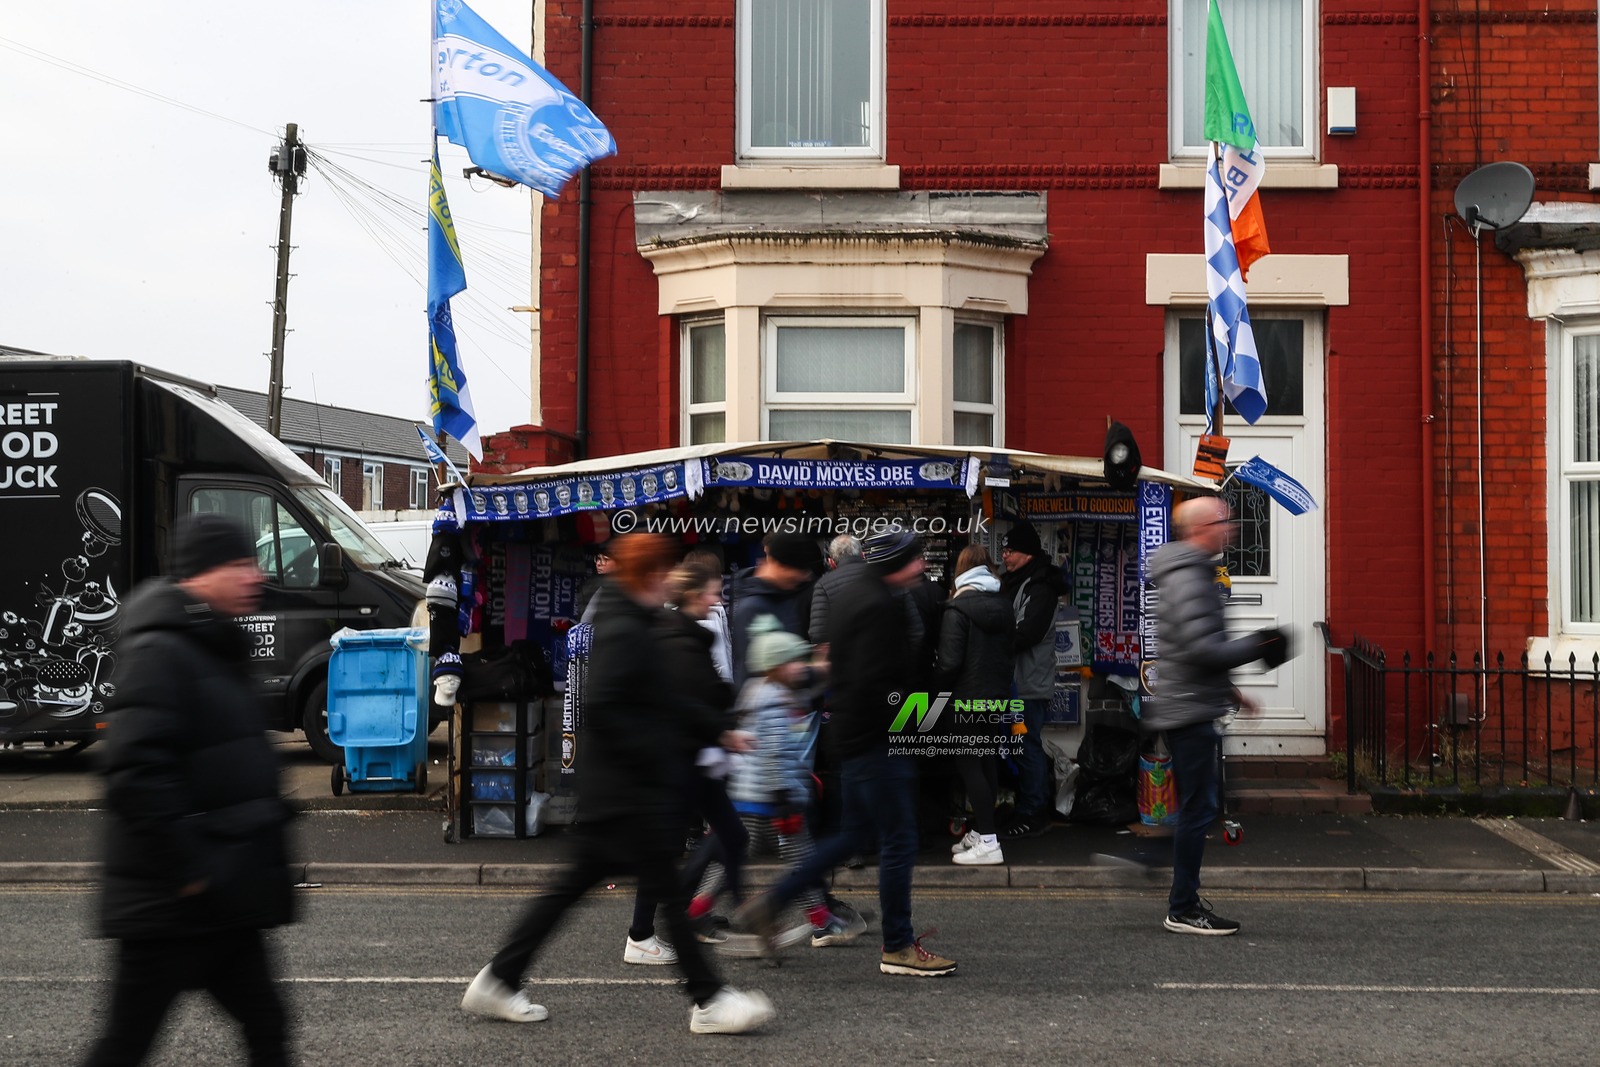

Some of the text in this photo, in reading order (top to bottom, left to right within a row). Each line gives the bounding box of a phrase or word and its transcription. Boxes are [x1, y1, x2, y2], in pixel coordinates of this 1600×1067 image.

[2, 431, 58, 459] OD
[0, 465, 58, 489] UCK
[526, 472, 620, 490] GOODISON LEGENDS
[759, 464, 914, 482] DAVID MOYES OBE
[1028, 496, 1136, 513] FAREWELL TO GOODISON
[1076, 562, 1094, 630] CELTIC
[1100, 562, 1116, 629] RANGERS
[1124, 564, 1138, 632] ULSTER
[240, 622, 275, 632] TREET
